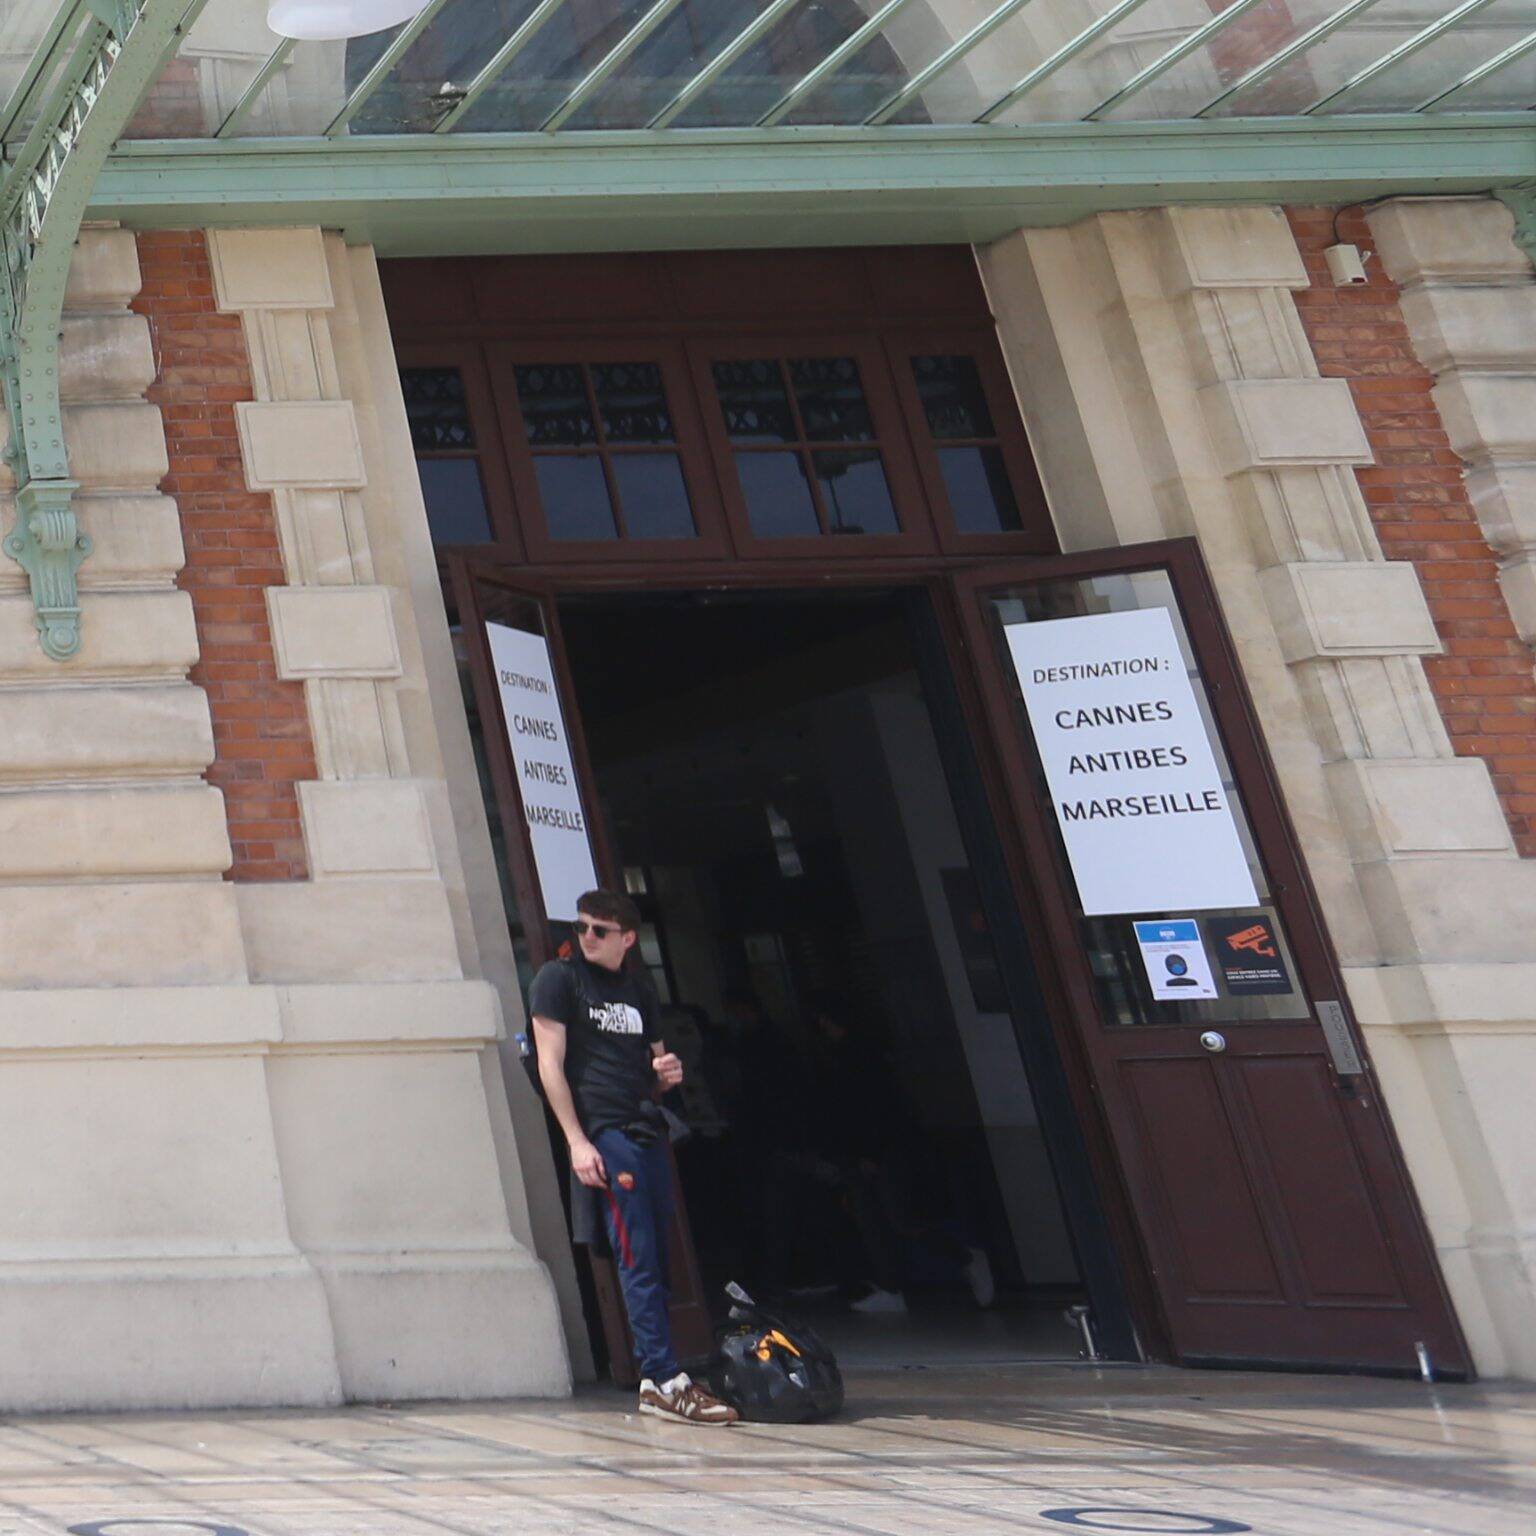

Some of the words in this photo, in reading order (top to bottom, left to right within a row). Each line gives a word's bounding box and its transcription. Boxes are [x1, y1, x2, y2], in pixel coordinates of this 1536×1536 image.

[501, 670, 547, 695] DESTINATION
[1033, 657, 1159, 684] DESTINATION
[514, 714, 558, 742] CANNES
[1055, 701, 1173, 730] CANNES
[524, 761, 568, 786] ANTIBES
[1069, 747, 1188, 775] ANTIBES
[525, 804, 584, 833] MARSEILLE
[1061, 790, 1222, 822] MARSEILLE
